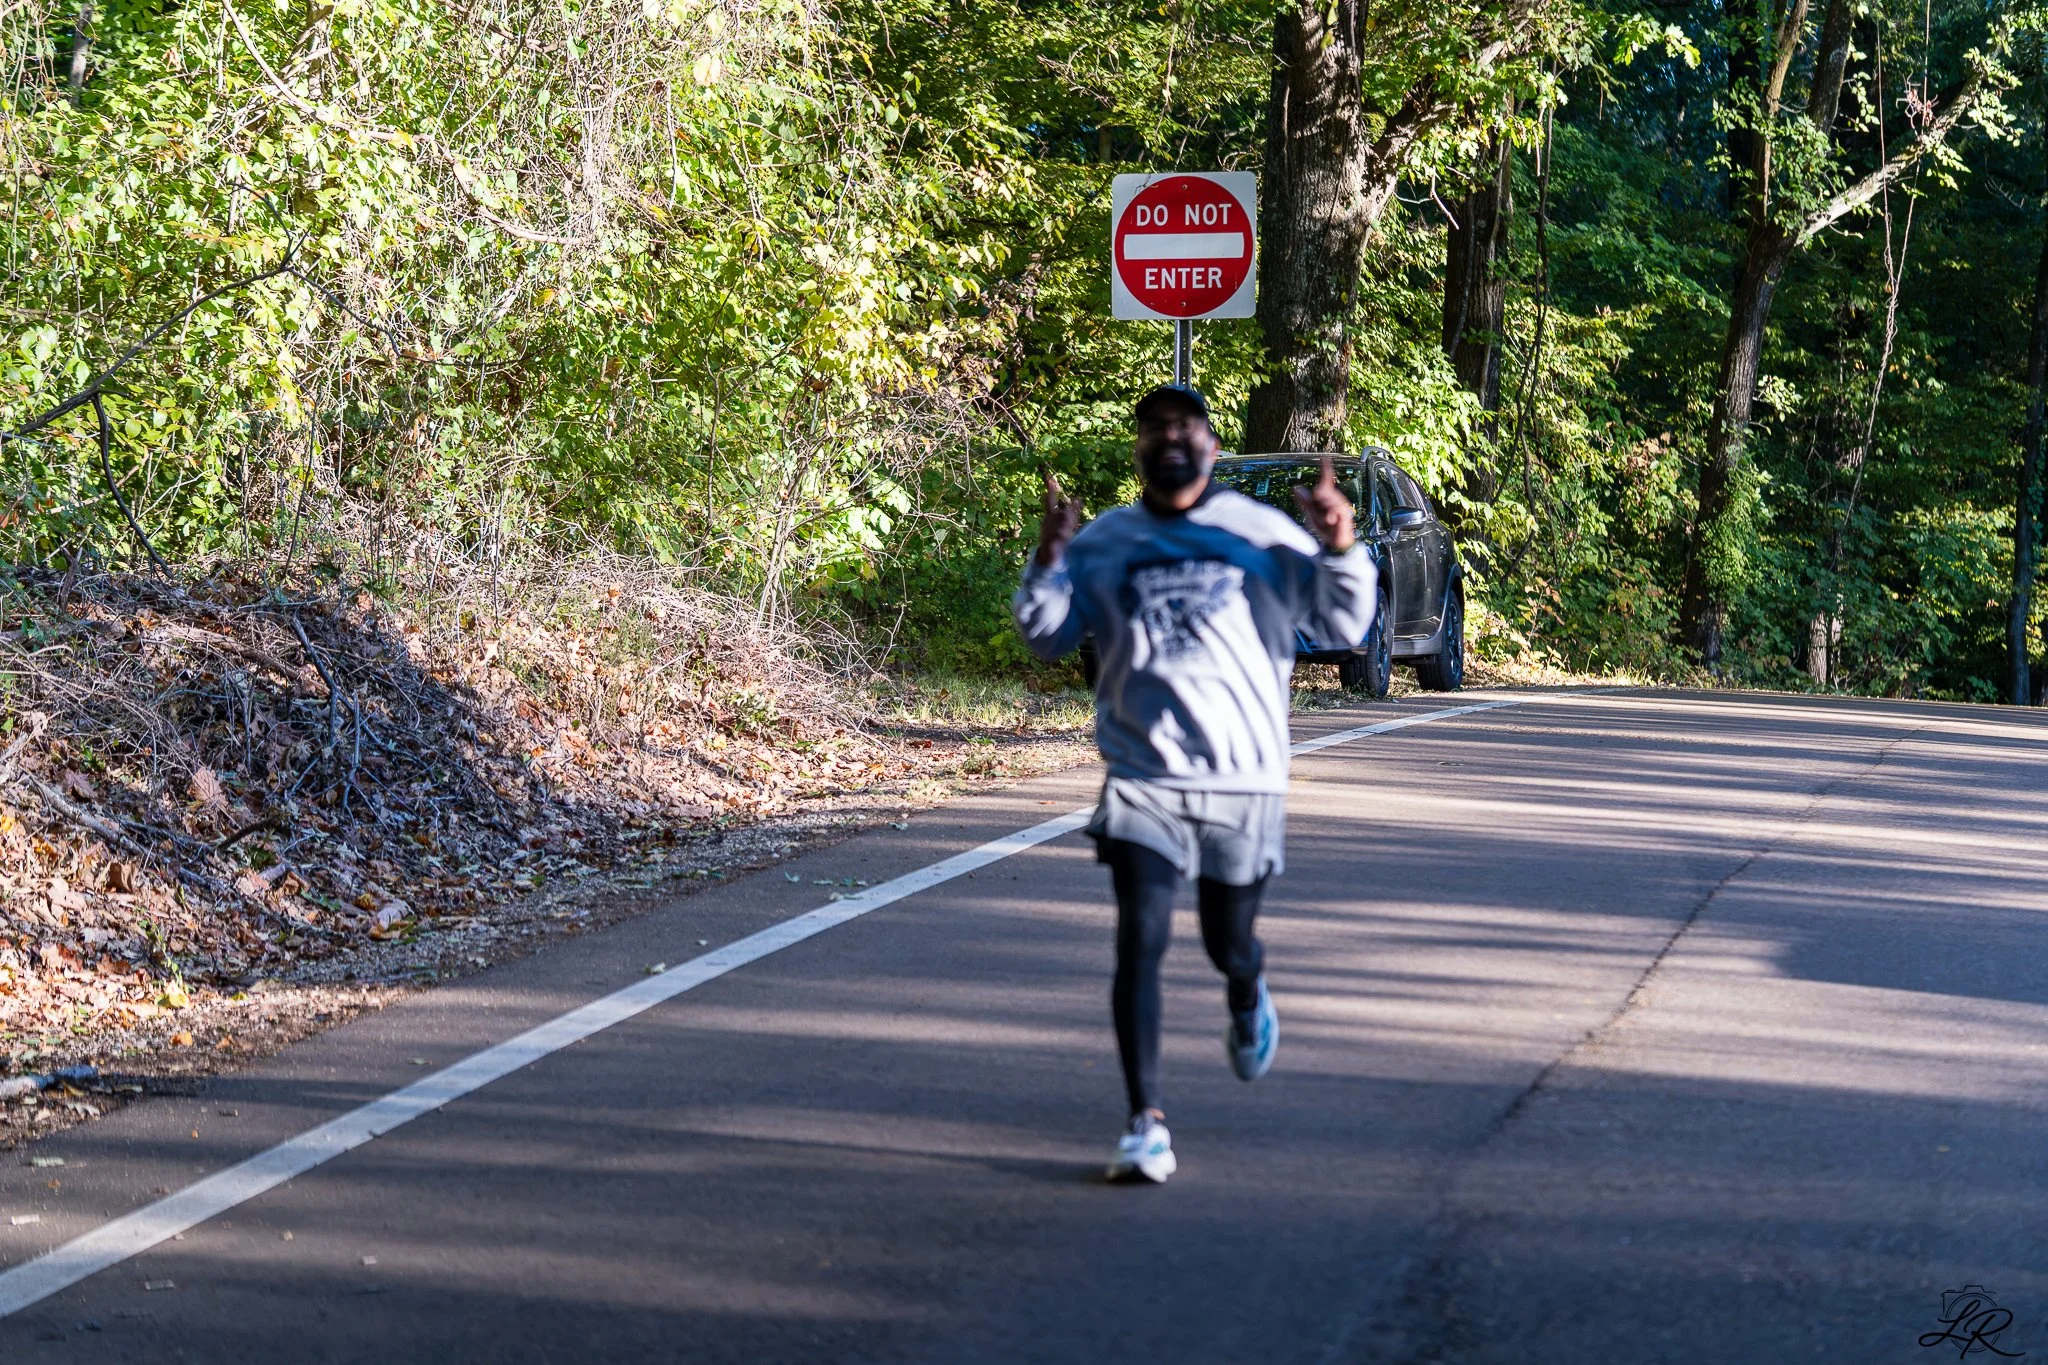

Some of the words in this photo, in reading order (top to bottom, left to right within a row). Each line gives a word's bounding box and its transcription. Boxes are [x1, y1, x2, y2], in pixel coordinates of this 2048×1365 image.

[1136, 204, 1169, 226] DO
[1184, 203, 1232, 225] NOT
[1145, 267, 1222, 289] ENTER
